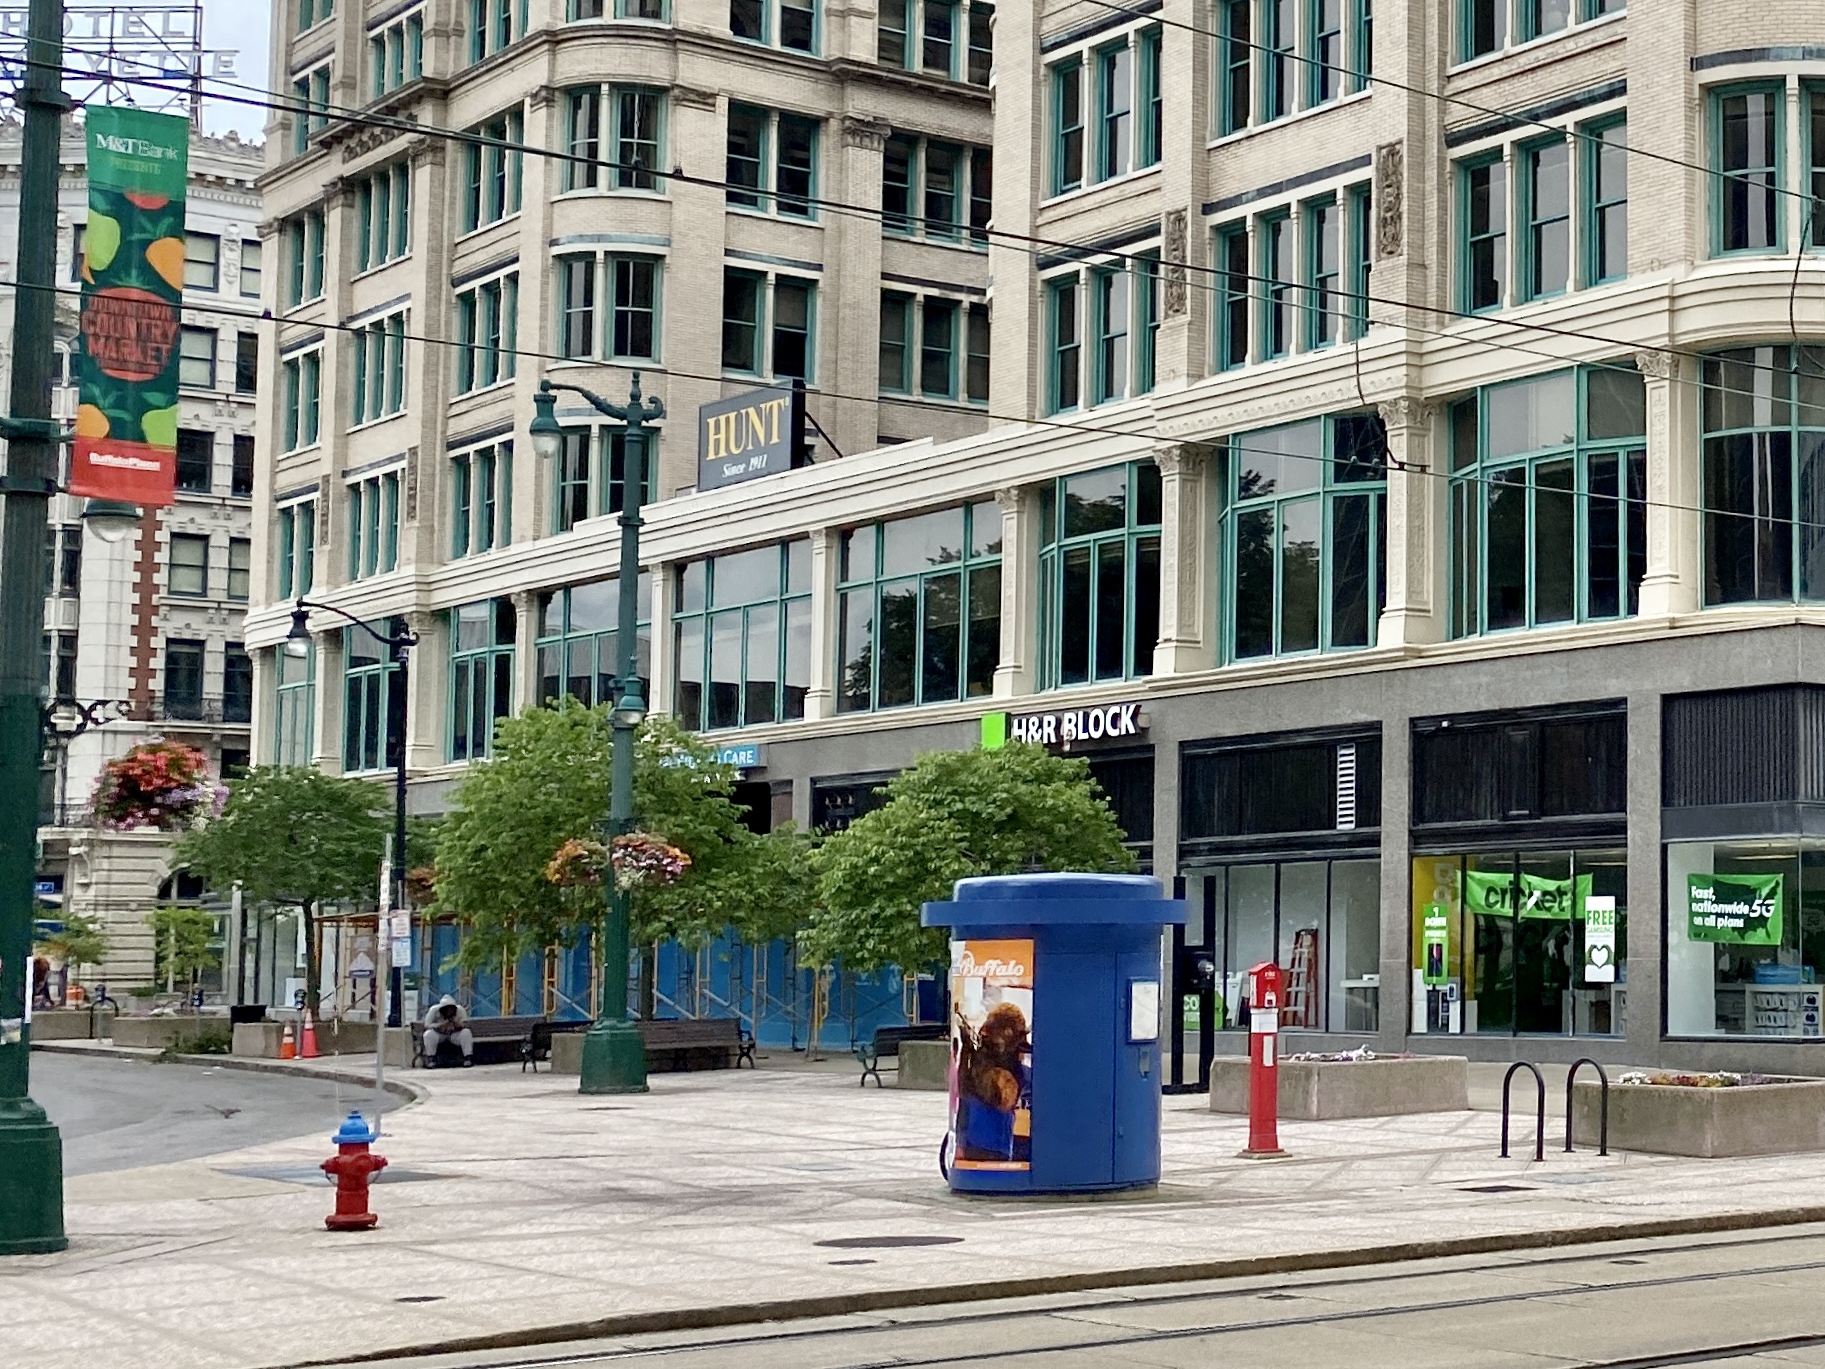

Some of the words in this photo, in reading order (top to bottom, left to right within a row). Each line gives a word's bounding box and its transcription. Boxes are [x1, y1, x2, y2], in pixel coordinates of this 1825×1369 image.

[3, 11, 185, 37] HTEL
[96, 133, 133, 154] M&T
[706, 398, 785, 460] HUNT
[722, 463, 746, 478] Since
[748, 453, 768, 471] 1911
[1012, 715, 1057, 744] H&R
[1063, 703, 1137, 742] BLOCK
[724, 749, 754, 764] CARE
[1484, 880, 1570, 914] cricket
[1691, 901, 1750, 915] nationwide
[1750, 899, 1775, 918] 5G
[1586, 910, 1614, 925] FREE
[1717, 915, 1744, 929] plans
[960, 951, 1025, 976] Buffalo
